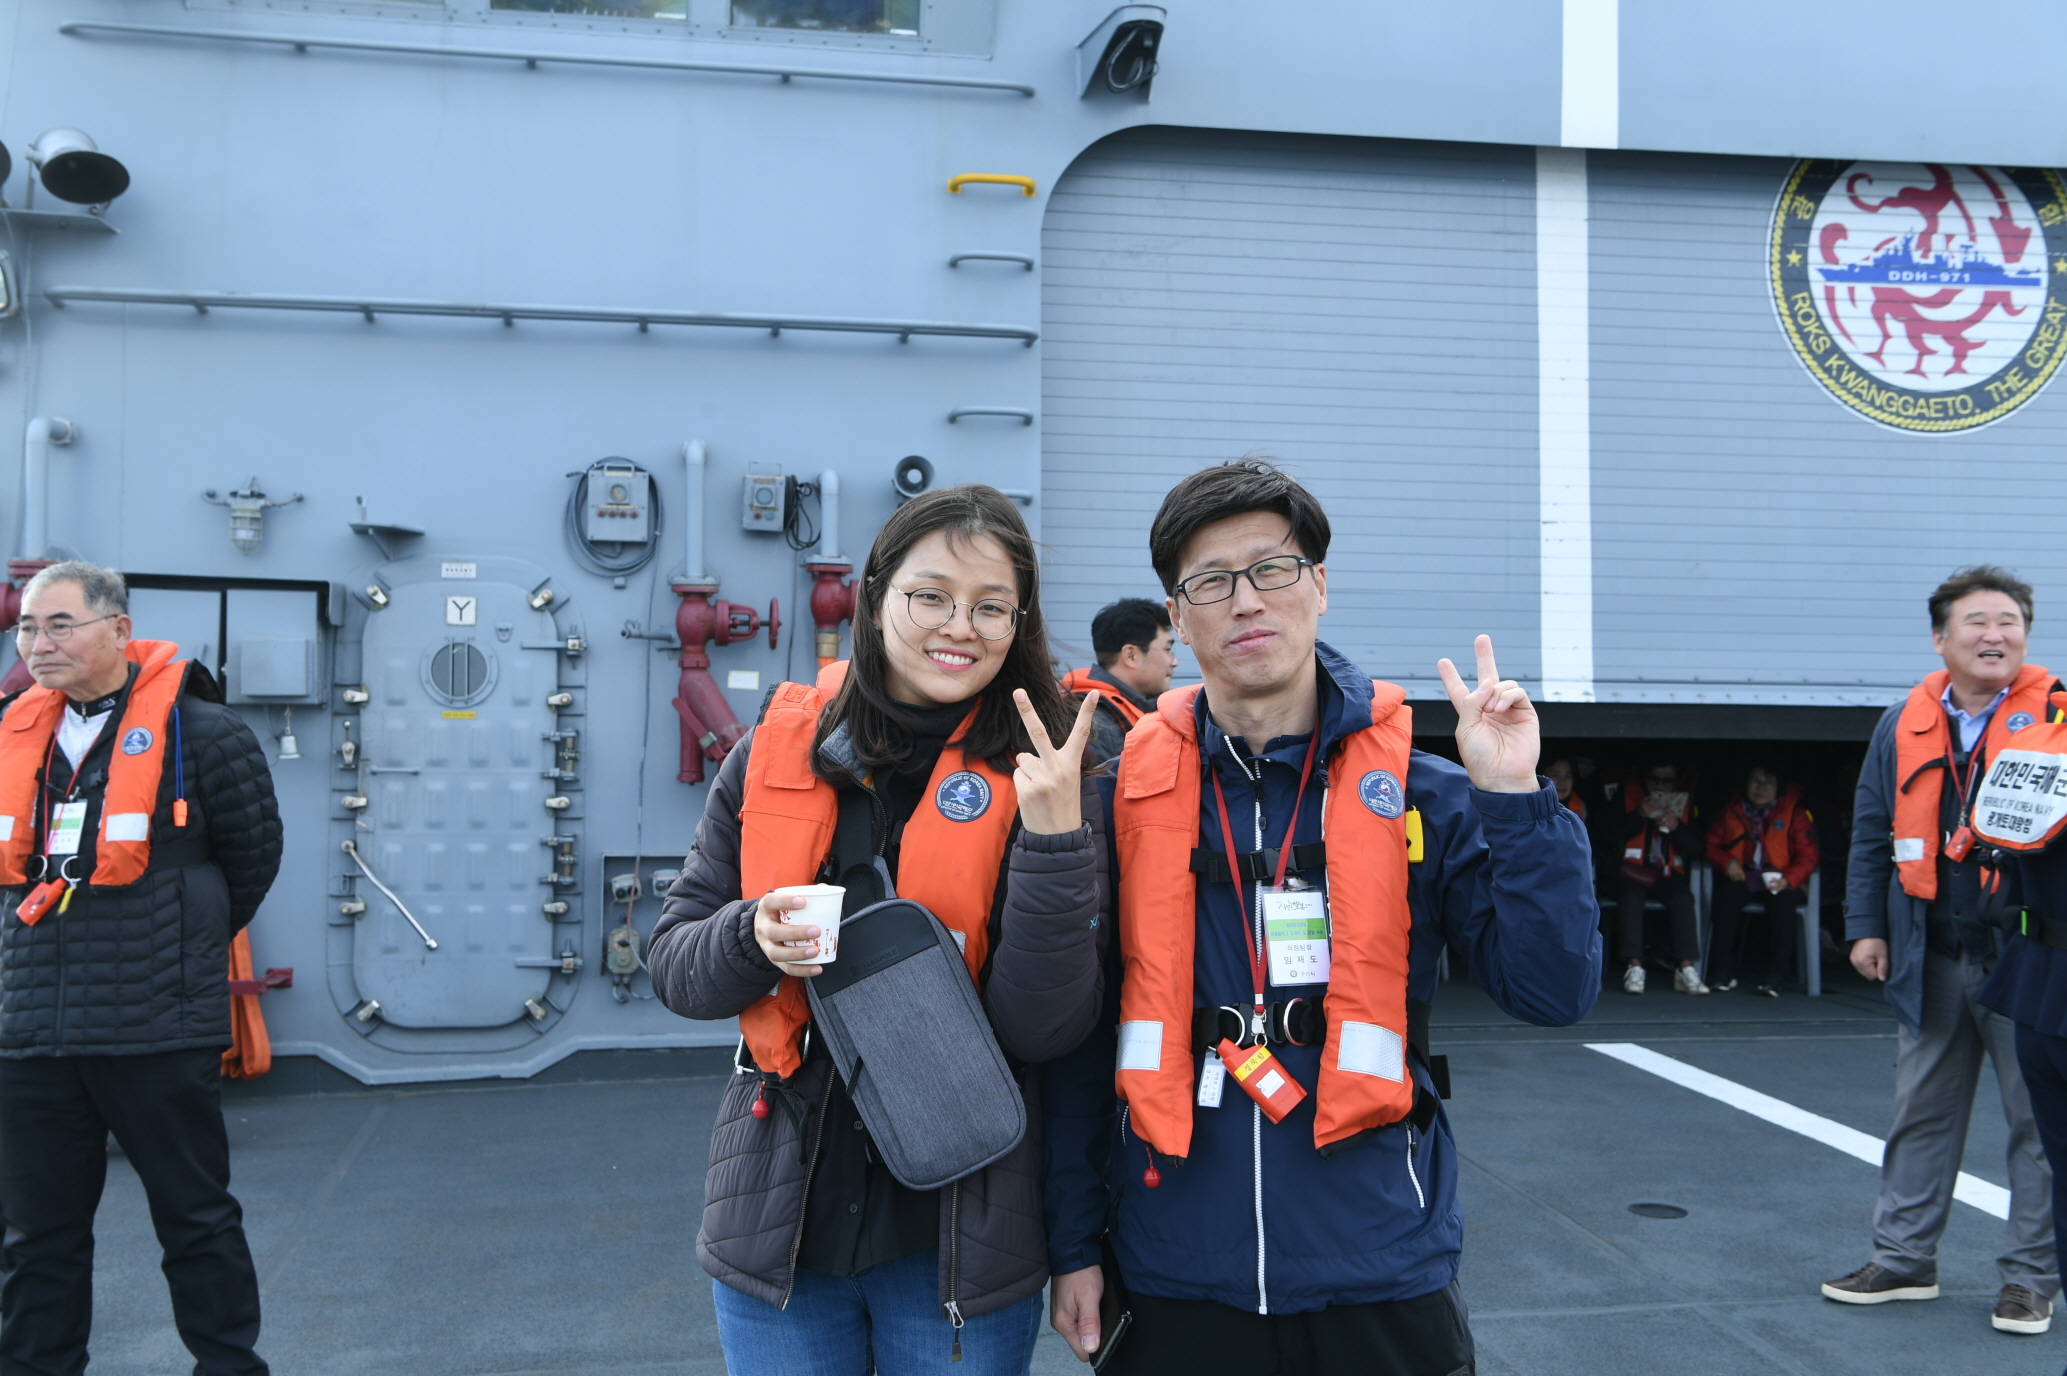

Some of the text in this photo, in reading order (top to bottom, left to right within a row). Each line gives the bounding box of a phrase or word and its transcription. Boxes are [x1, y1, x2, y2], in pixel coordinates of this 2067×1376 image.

[1888, 269, 1971, 284] DDH-971
[1791, 291, 1832, 355] ROKS
[1985, 366, 2029, 403] THE
[2024, 296, 2067, 368] GREAT
[452, 600, 471, 621] Y
